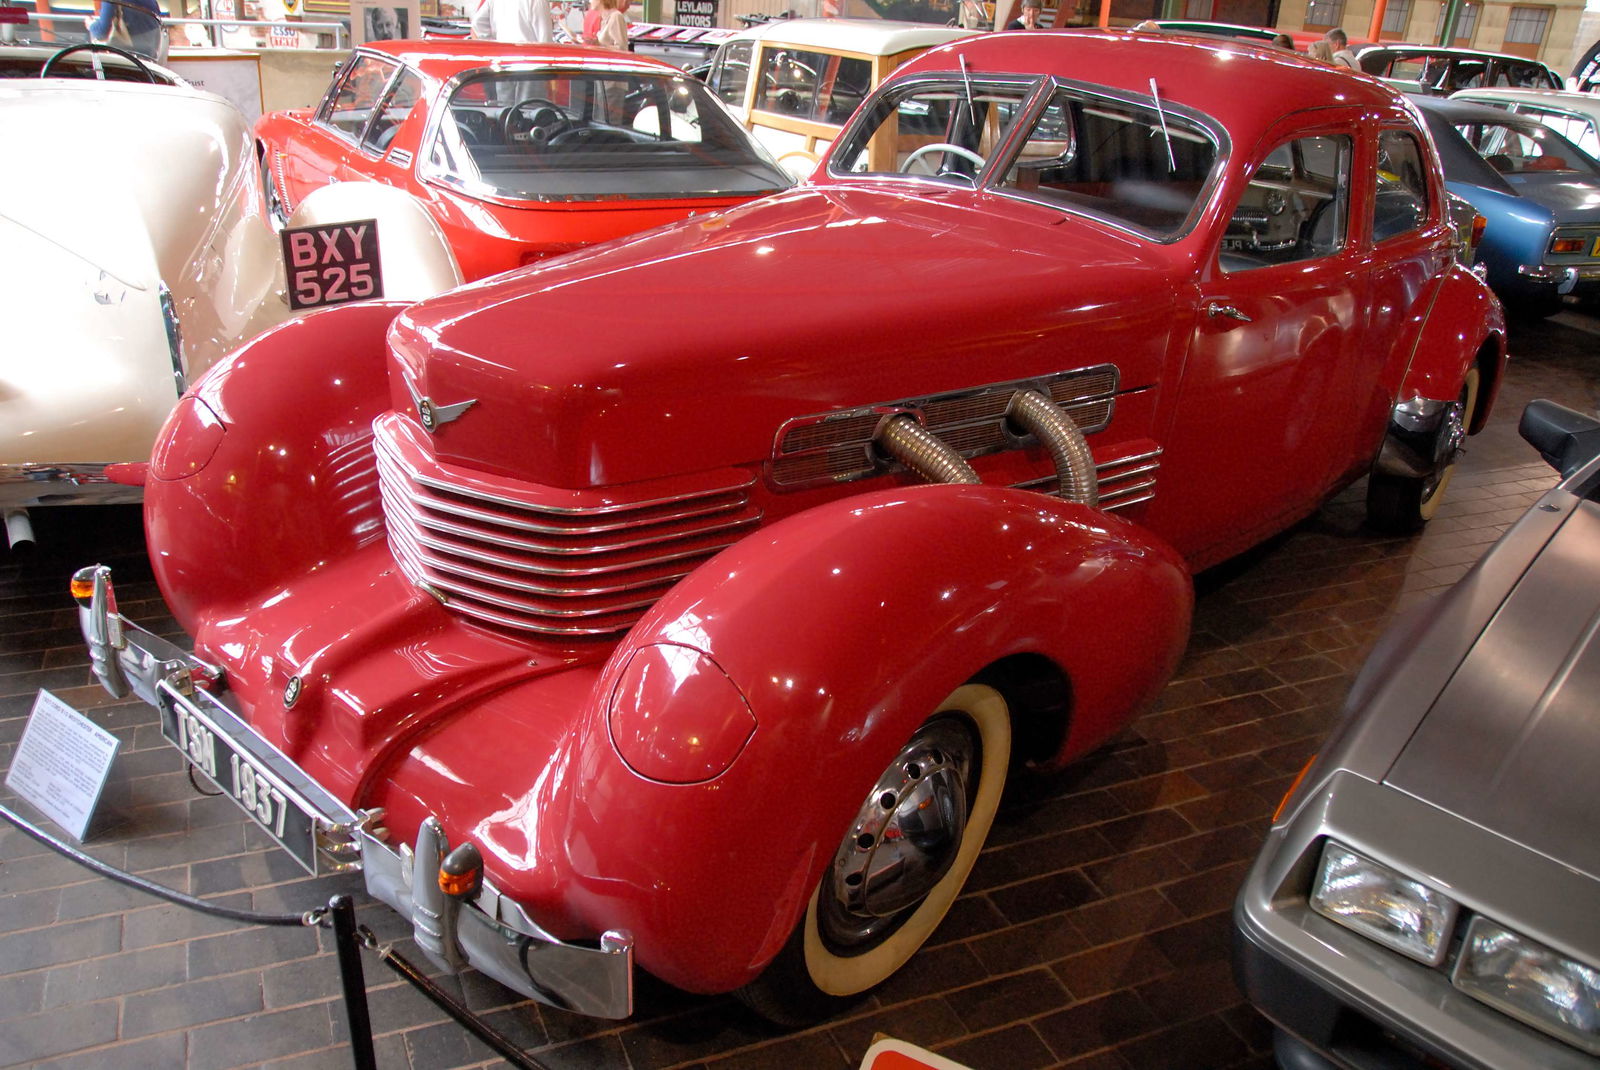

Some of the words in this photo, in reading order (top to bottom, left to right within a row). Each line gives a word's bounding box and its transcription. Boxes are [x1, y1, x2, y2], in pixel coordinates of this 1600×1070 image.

[677, 1, 714, 14] LEYLAND
[680, 14, 711, 27] MOTORS
[290, 225, 367, 267] BXY
[296, 263, 374, 305] 525
[174, 702, 217, 778] TSM
[230, 753, 287, 839] 1937
